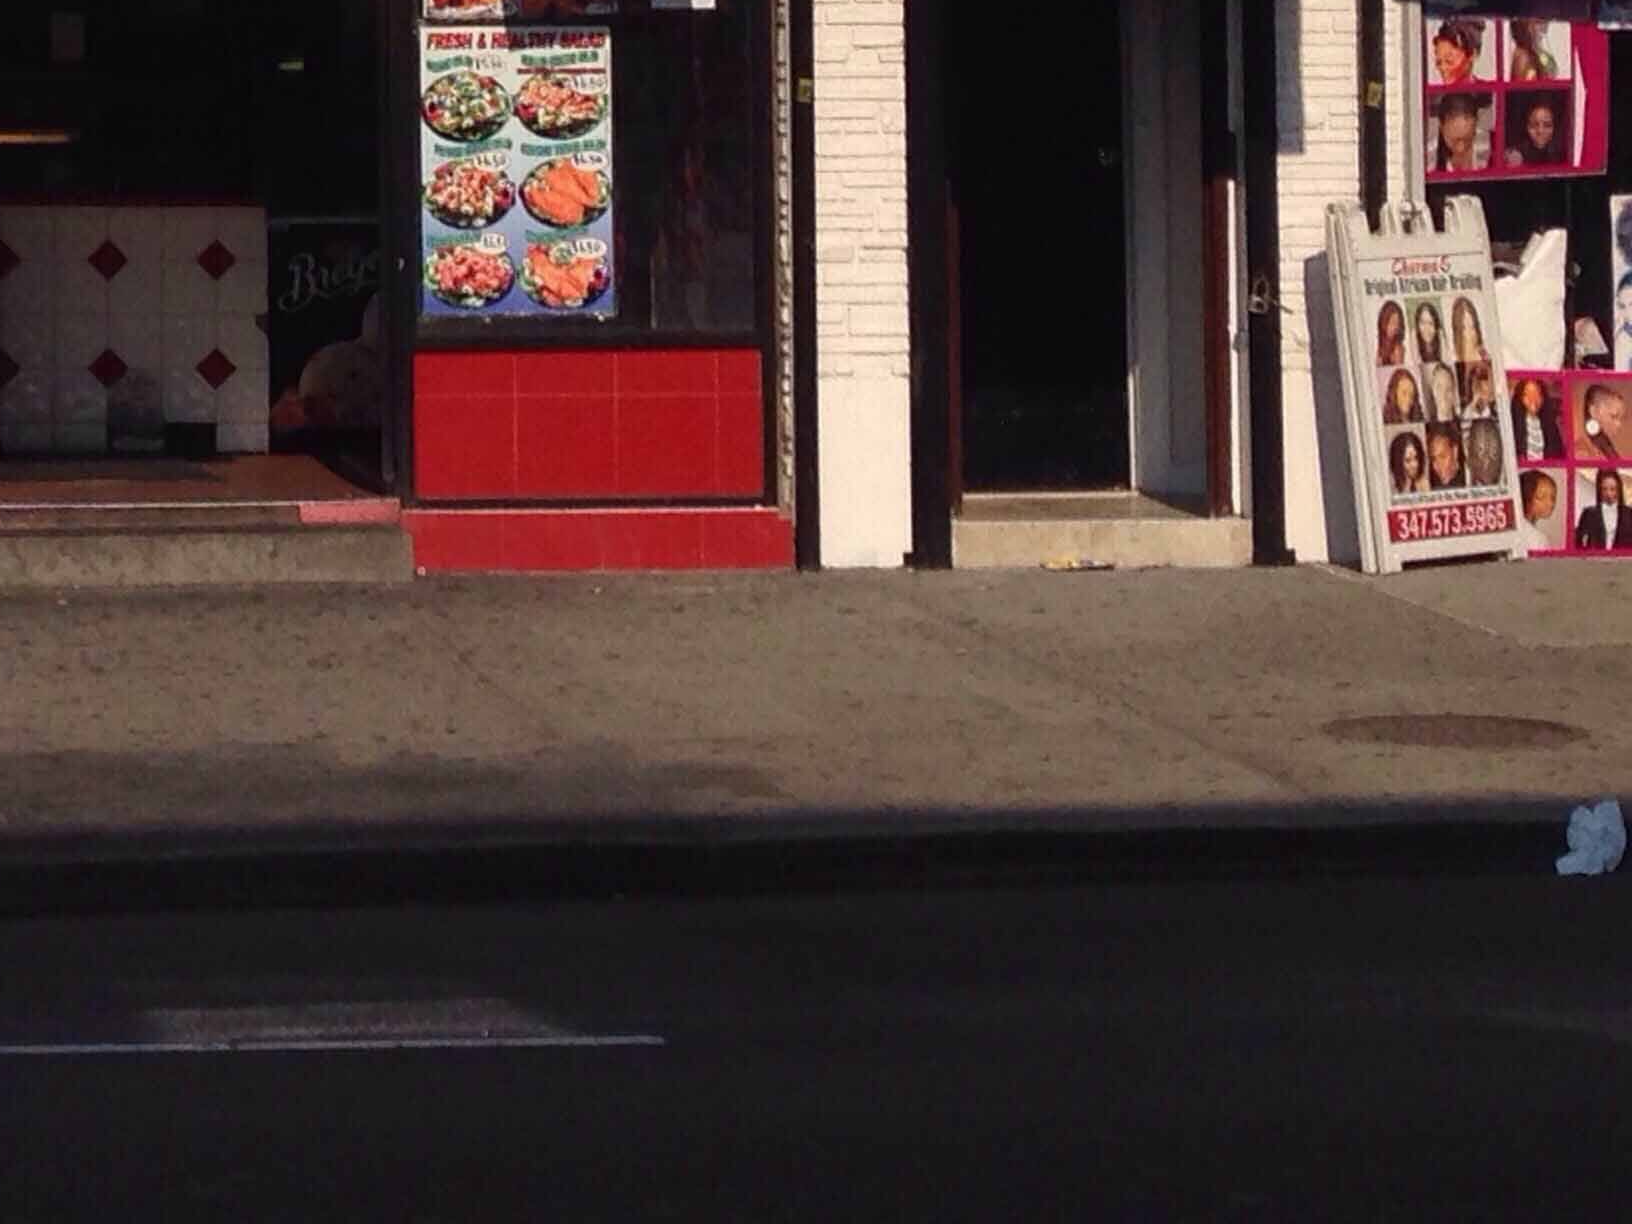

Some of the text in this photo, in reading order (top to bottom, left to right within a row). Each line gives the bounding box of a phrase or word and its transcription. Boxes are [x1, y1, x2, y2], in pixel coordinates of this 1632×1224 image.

[426, 32, 473, 50] FRESH
[477, 32, 487, 49] &
[1397, 503, 1507, 539] 347.573.5965
